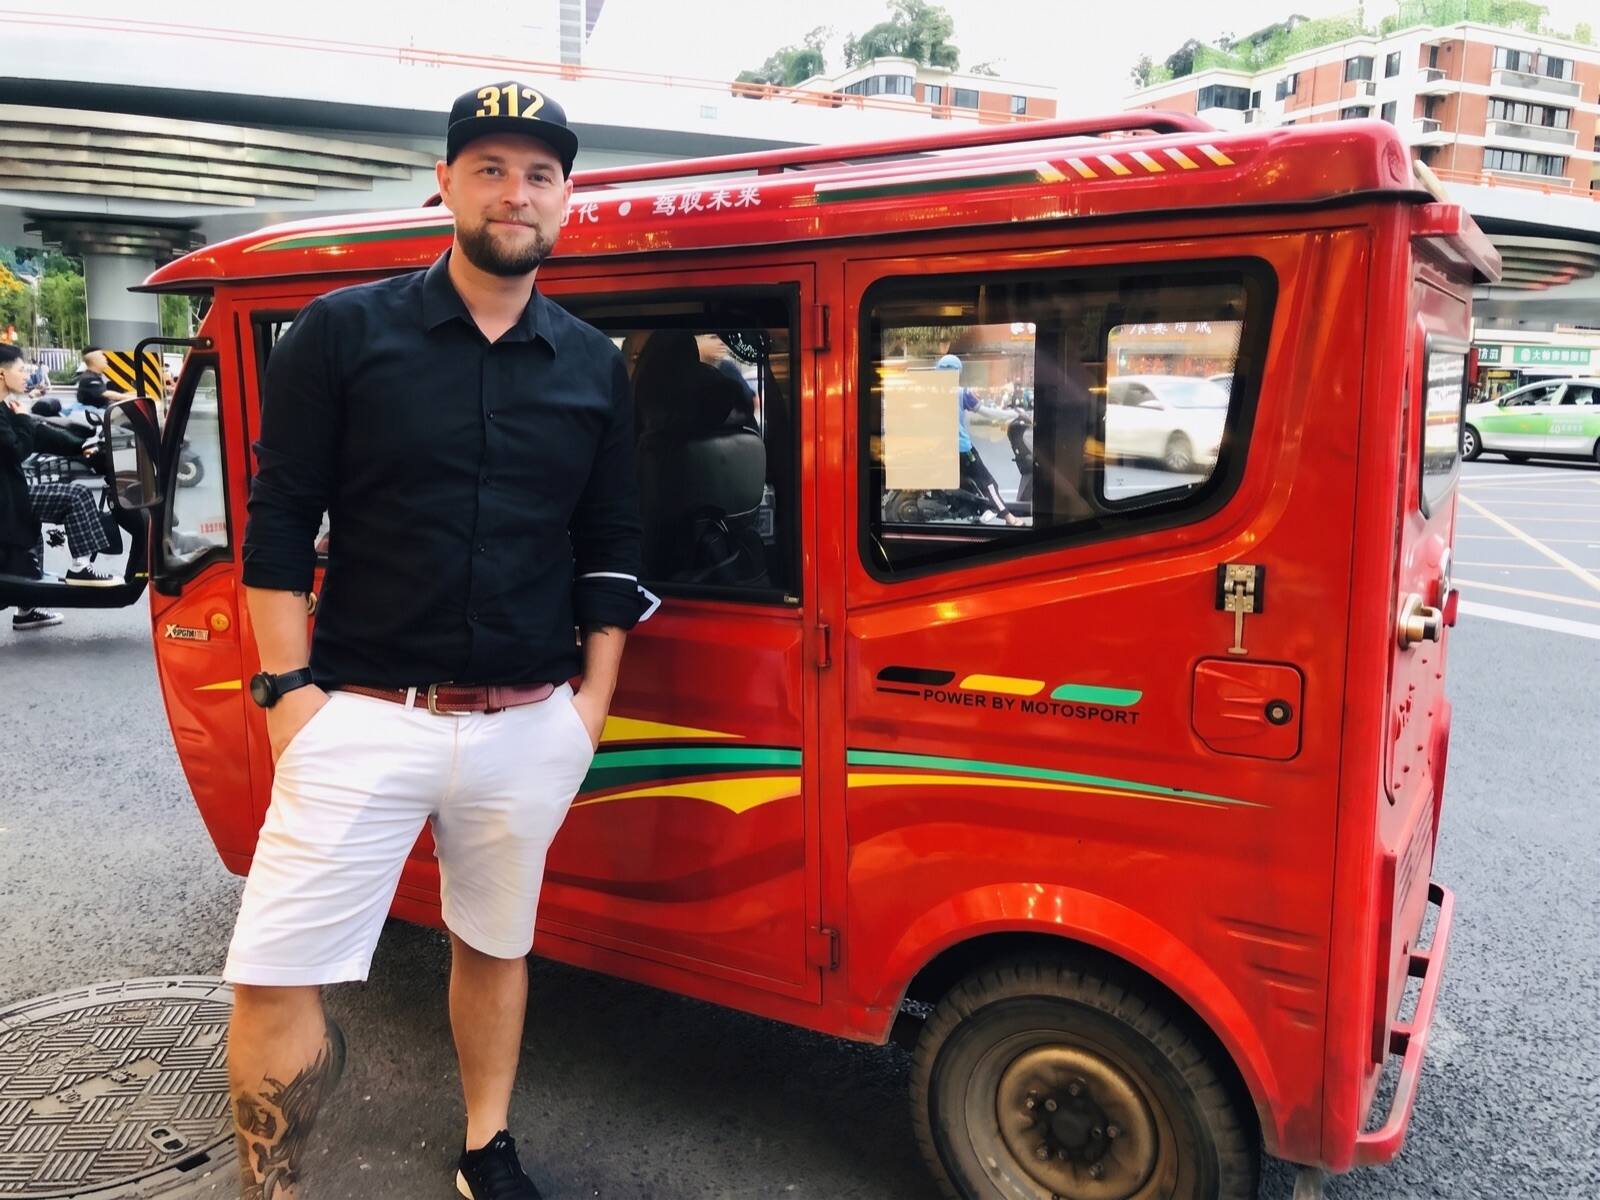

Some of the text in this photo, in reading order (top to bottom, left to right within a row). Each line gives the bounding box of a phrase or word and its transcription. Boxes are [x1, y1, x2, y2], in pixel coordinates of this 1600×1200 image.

[475, 83, 545, 120] 312
[924, 689, 1141, 725] POWER BY MOTOSPORT
